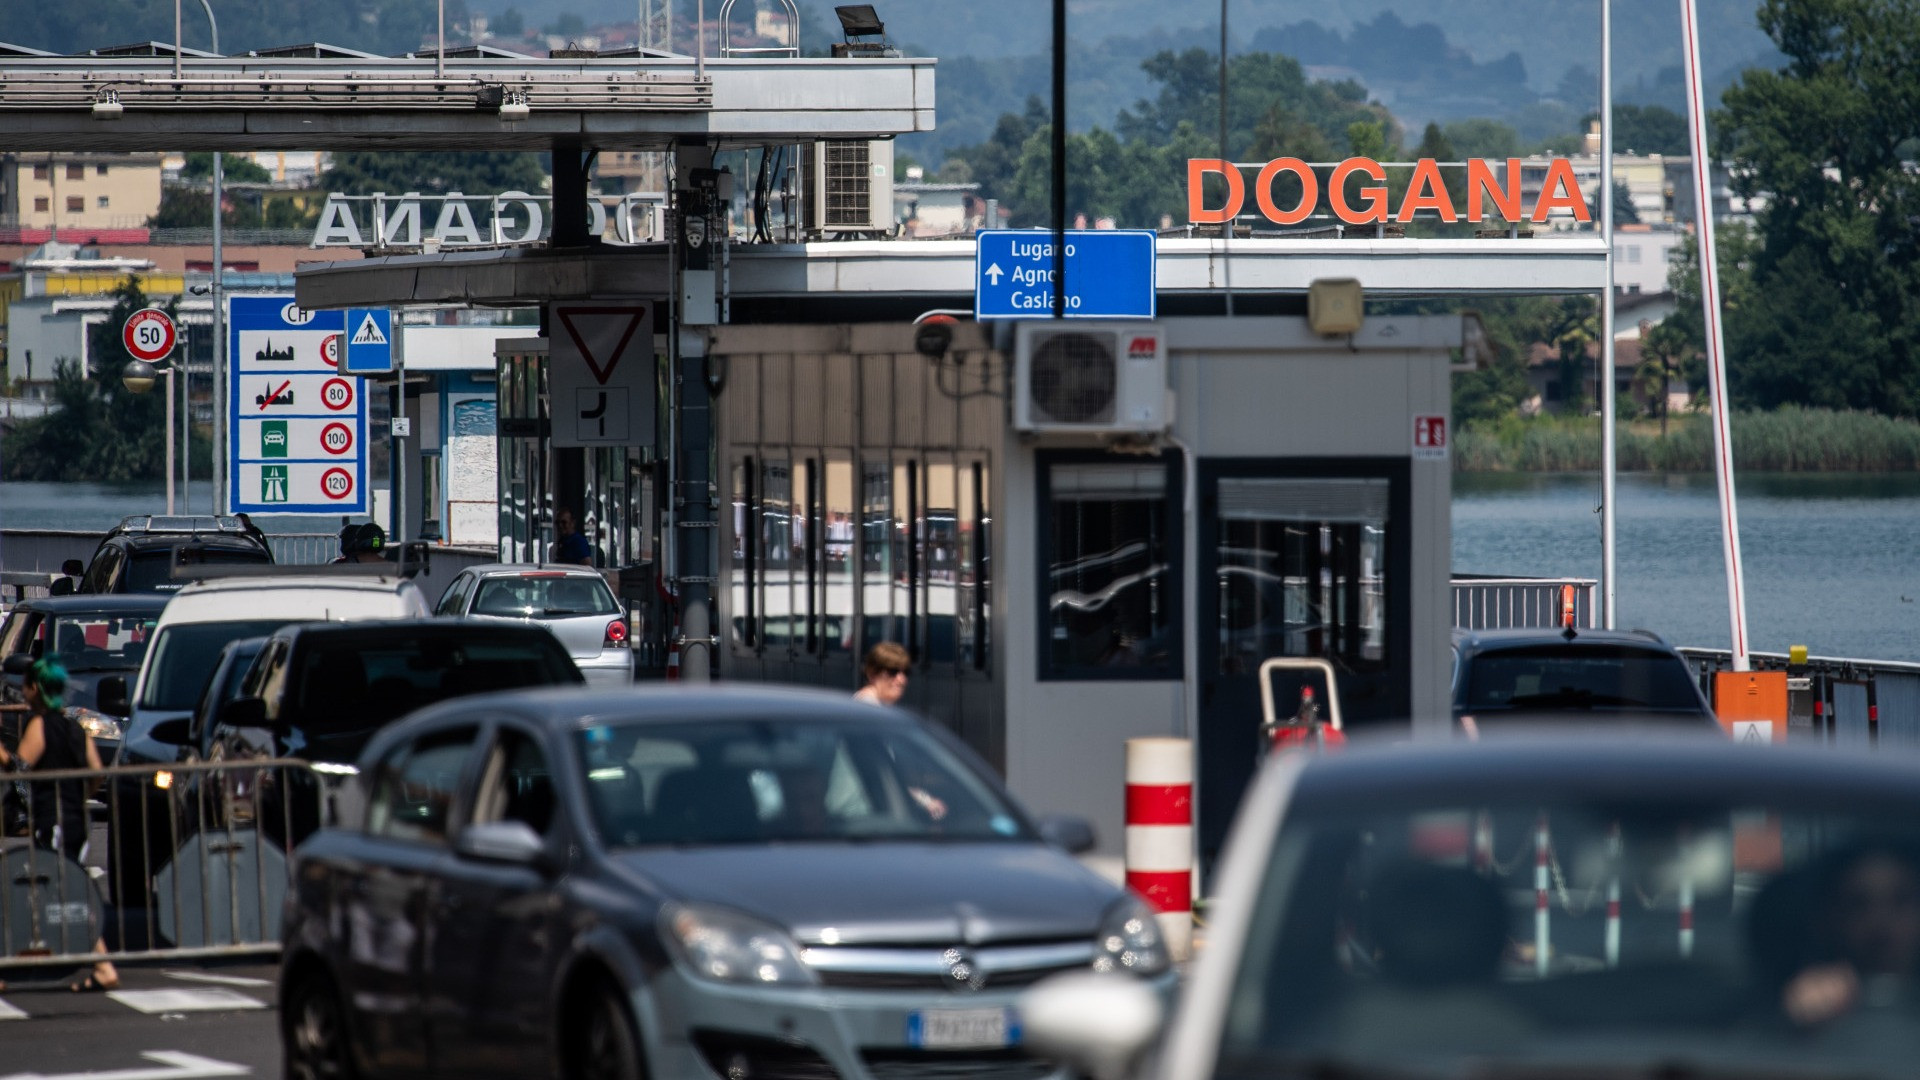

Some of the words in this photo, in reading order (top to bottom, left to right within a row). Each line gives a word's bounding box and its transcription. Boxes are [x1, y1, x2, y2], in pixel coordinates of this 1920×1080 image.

[1187, 156, 1592, 225] DOGANA
[287, 305, 308, 322] CH
[139, 327, 160, 345] 50
[329, 344, 337, 357] 5
[329, 388, 344, 401] 80
[327, 432, 346, 445] 100
[327, 477, 346, 490] 120
